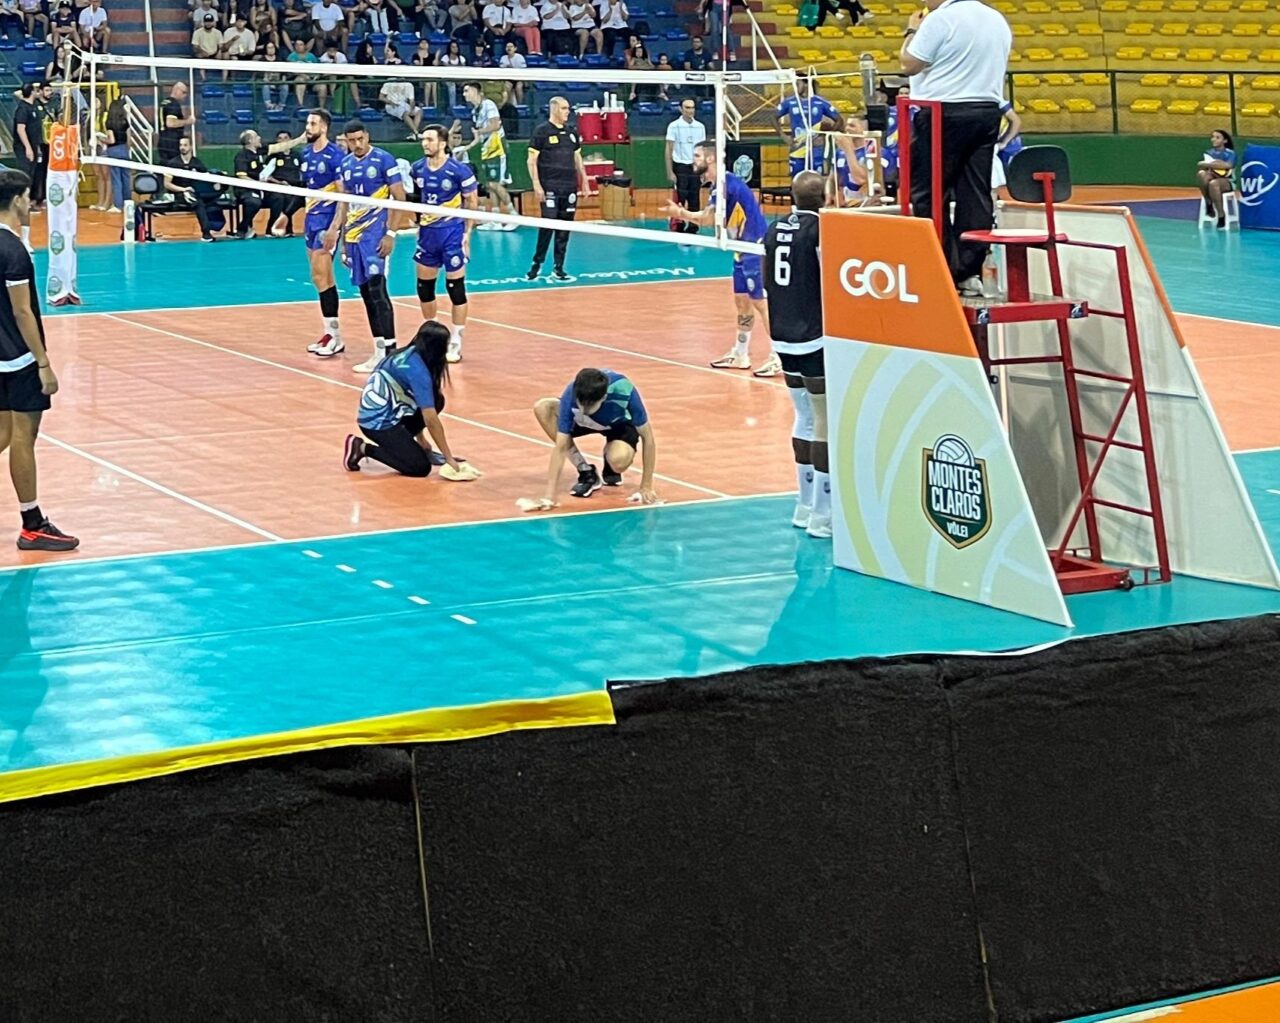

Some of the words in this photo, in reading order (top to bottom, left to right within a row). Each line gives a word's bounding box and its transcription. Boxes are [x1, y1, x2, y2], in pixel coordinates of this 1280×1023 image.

[52, 132, 66, 160] GOL
[774, 245, 791, 287] 6
[839, 258, 919, 304] GOL
[927, 460, 982, 496] MONTES
[931, 486, 981, 521] CLAROS
